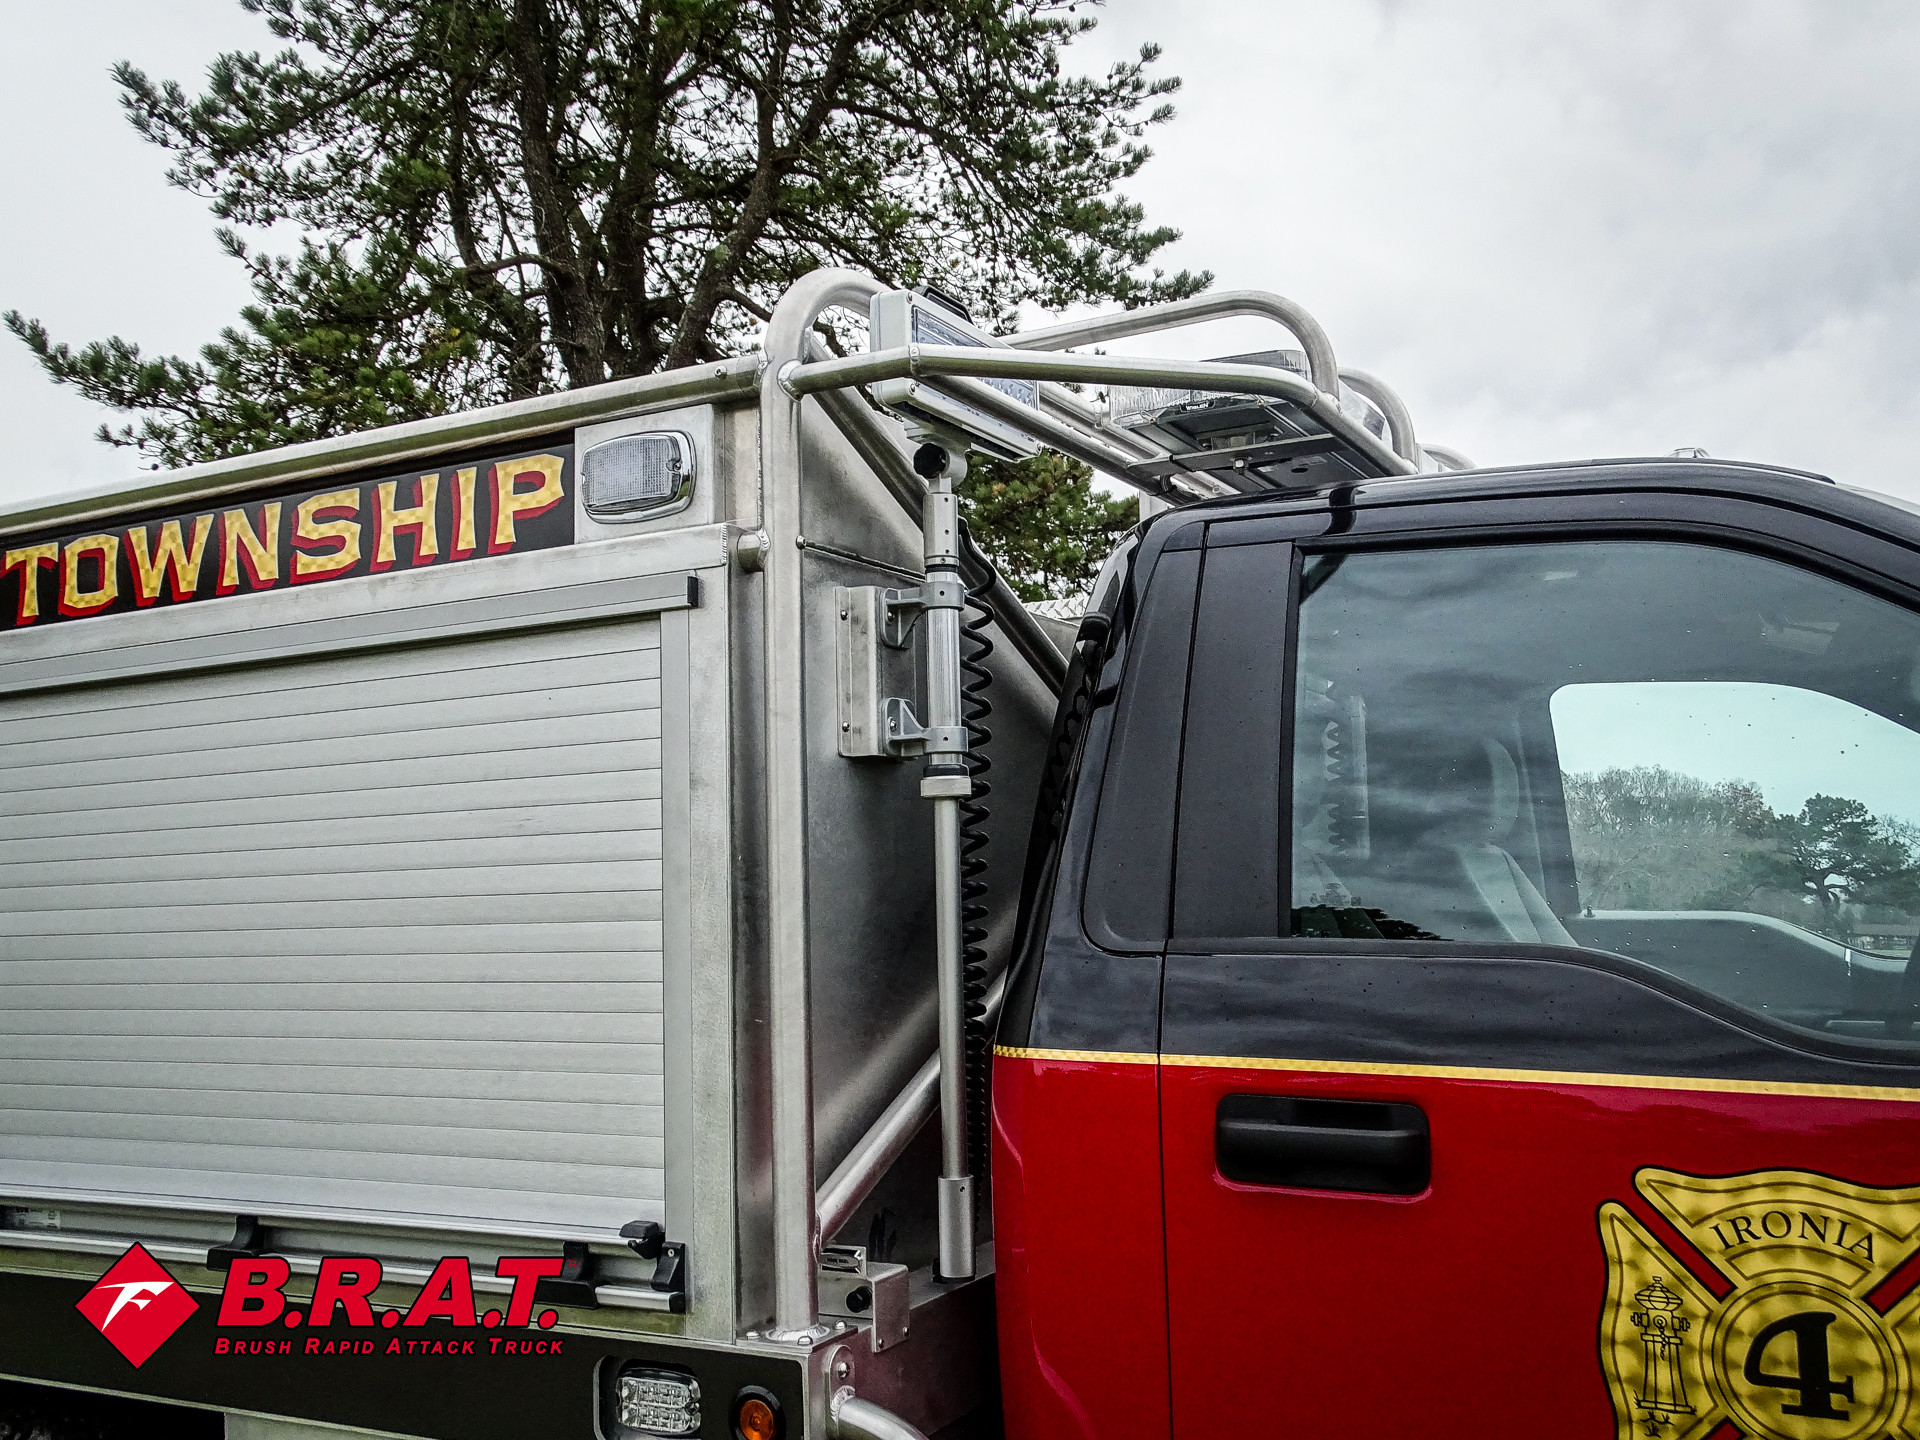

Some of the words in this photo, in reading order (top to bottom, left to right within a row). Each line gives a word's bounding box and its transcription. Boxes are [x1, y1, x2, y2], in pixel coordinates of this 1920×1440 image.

[2, 454, 564, 622] TOWNSHIP
[1709, 1210, 1875, 1264] IRONIA
[1744, 1311, 1855, 1421] 4
